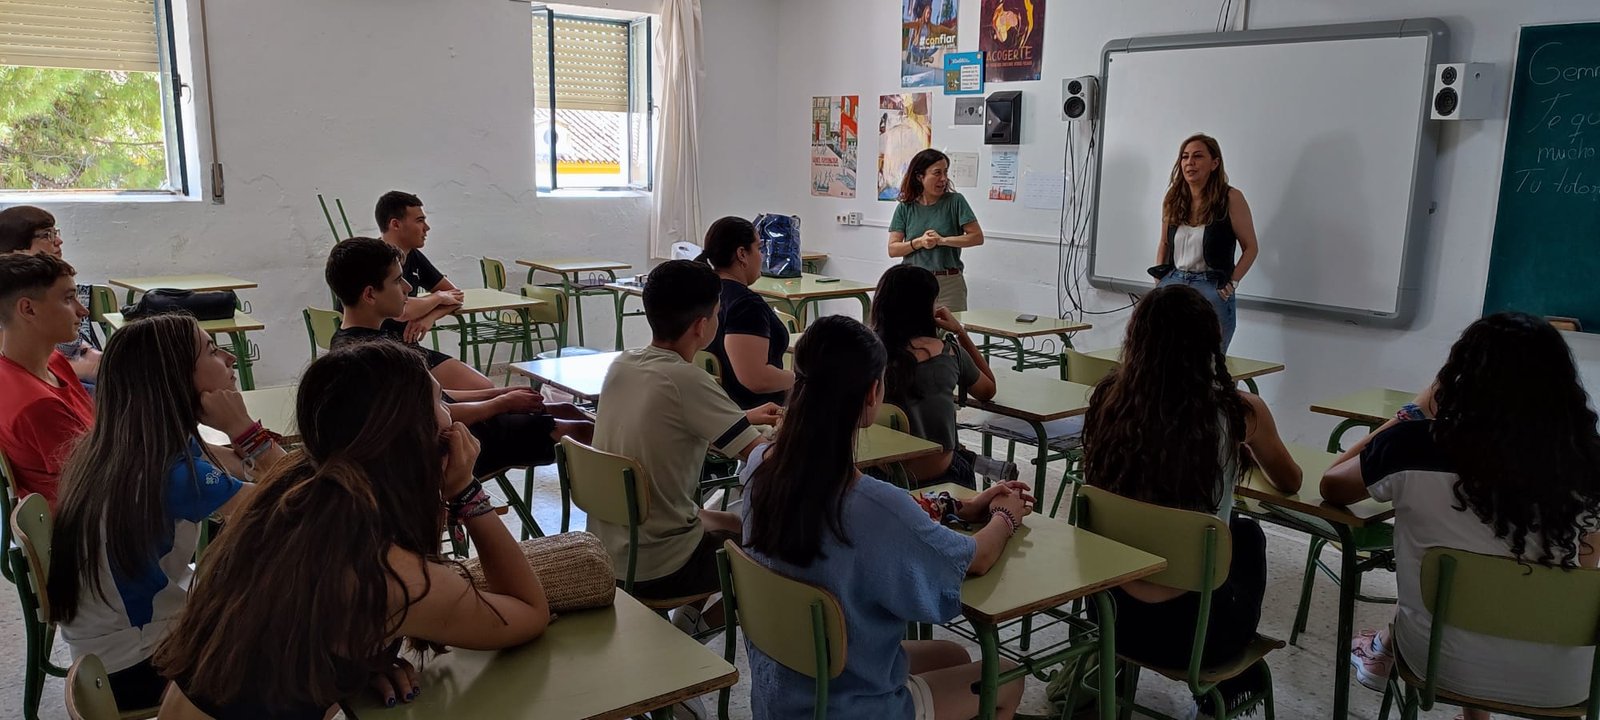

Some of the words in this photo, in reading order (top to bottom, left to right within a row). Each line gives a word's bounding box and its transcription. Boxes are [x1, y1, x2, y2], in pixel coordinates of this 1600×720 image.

[919, 33, 956, 46] #confiar
[986, 46, 1033, 61] ACOGERTE
[1528, 92, 1573, 133] Te
[1537, 139, 1596, 163] mucho
[1515, 168, 1545, 193] Tu
[1553, 168, 1600, 194] tutor
